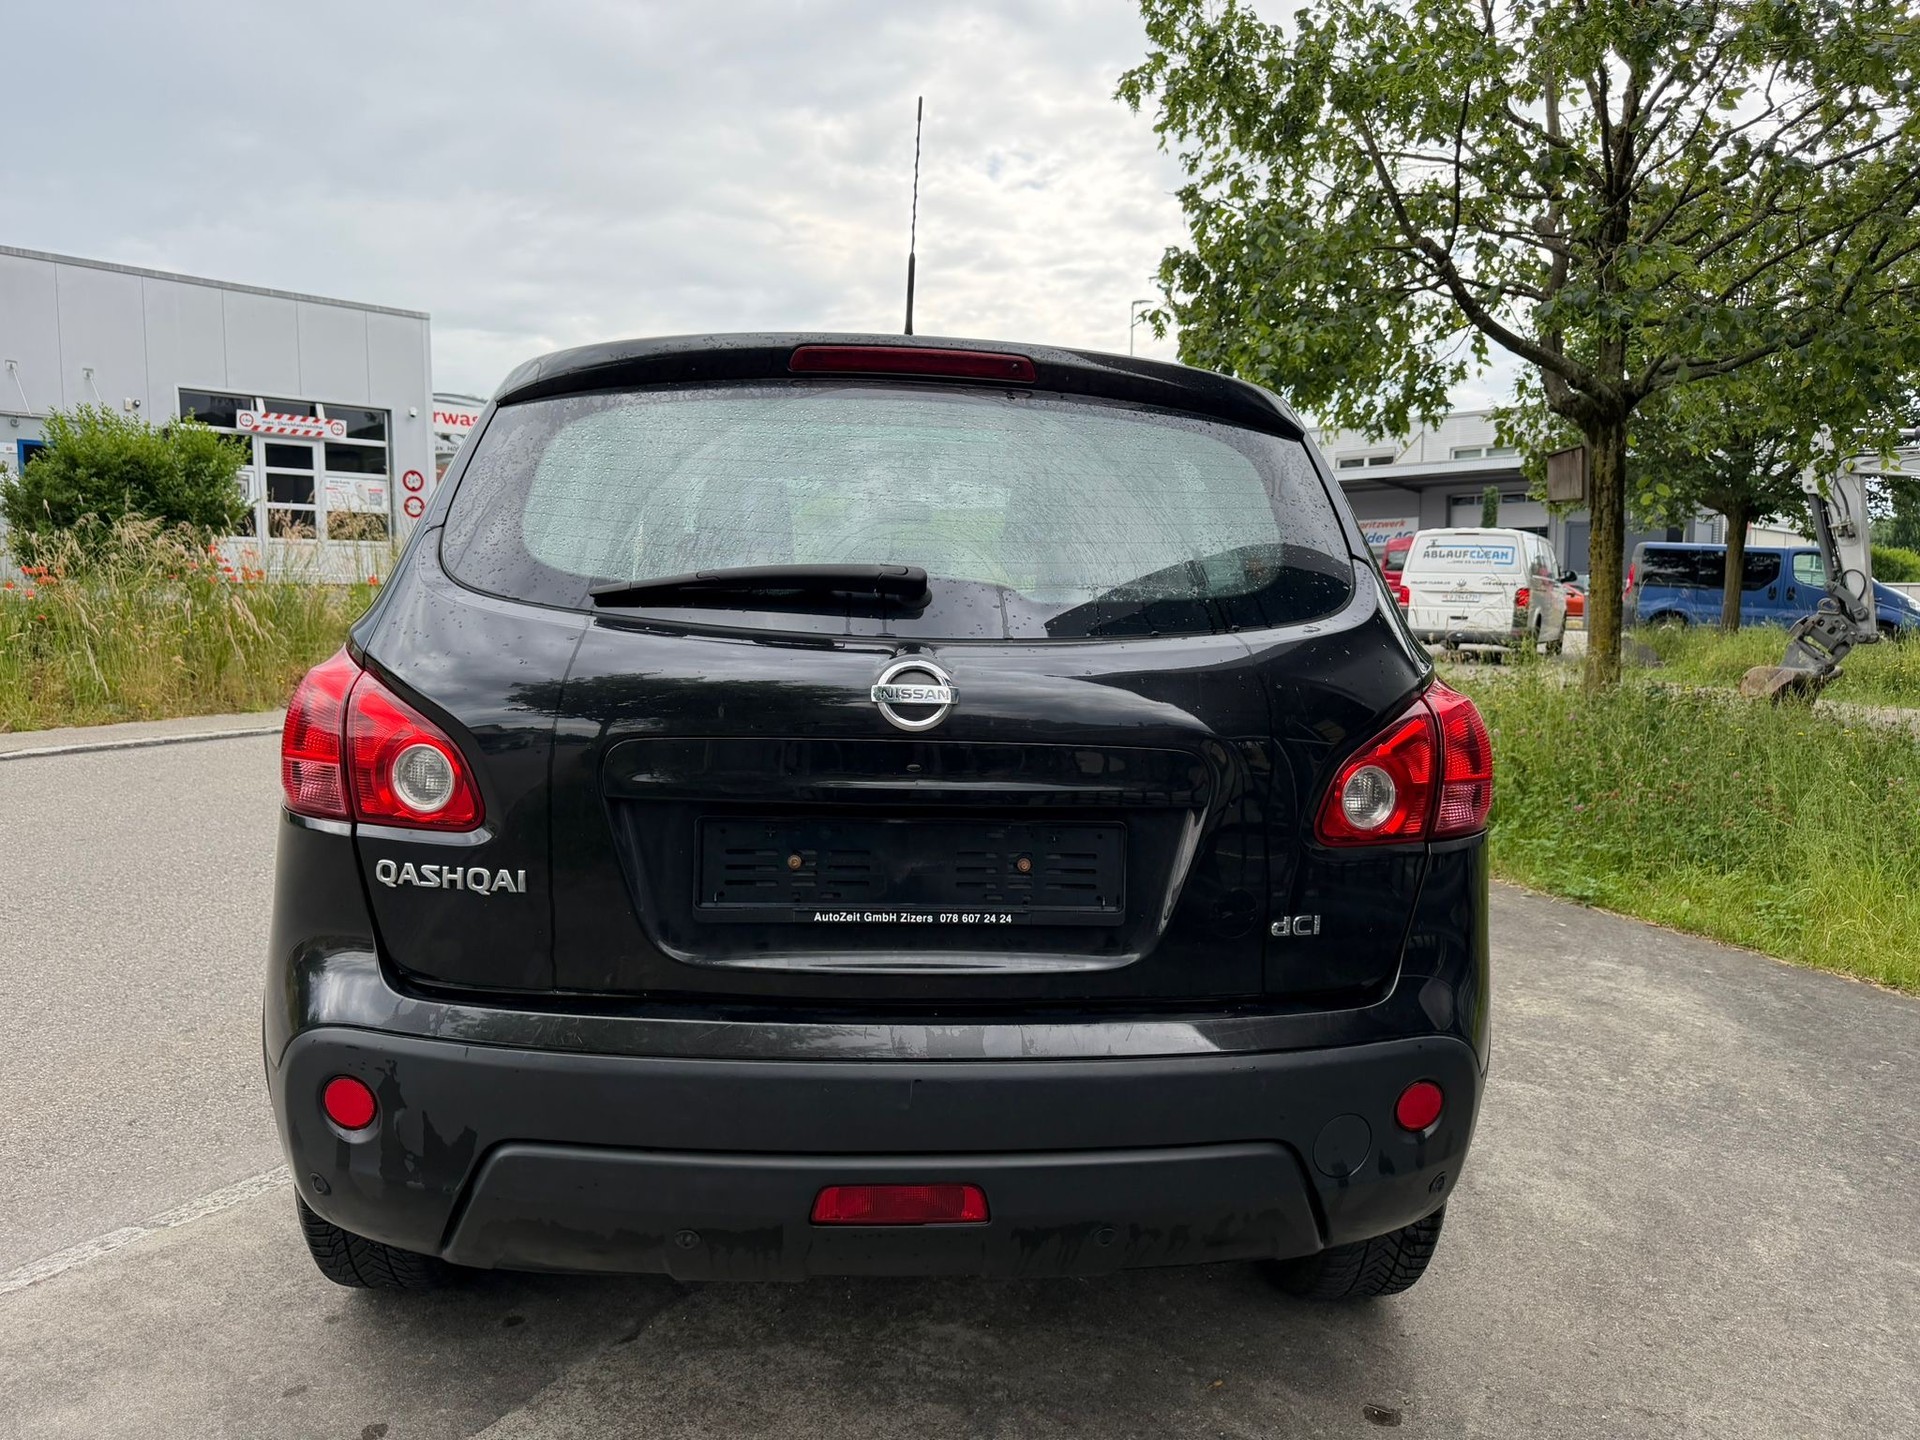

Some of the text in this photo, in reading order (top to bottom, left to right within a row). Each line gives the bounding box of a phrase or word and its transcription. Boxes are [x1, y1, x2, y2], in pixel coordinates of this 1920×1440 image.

[1423, 549, 1509, 560] ABLAUFCLEAN
[880, 688, 950, 700] NISSAN
[375, 859, 527, 896] QASHQAI
[814, 912, 1013, 924] AutoZeit GmbH Zizers 078 607 24 24
